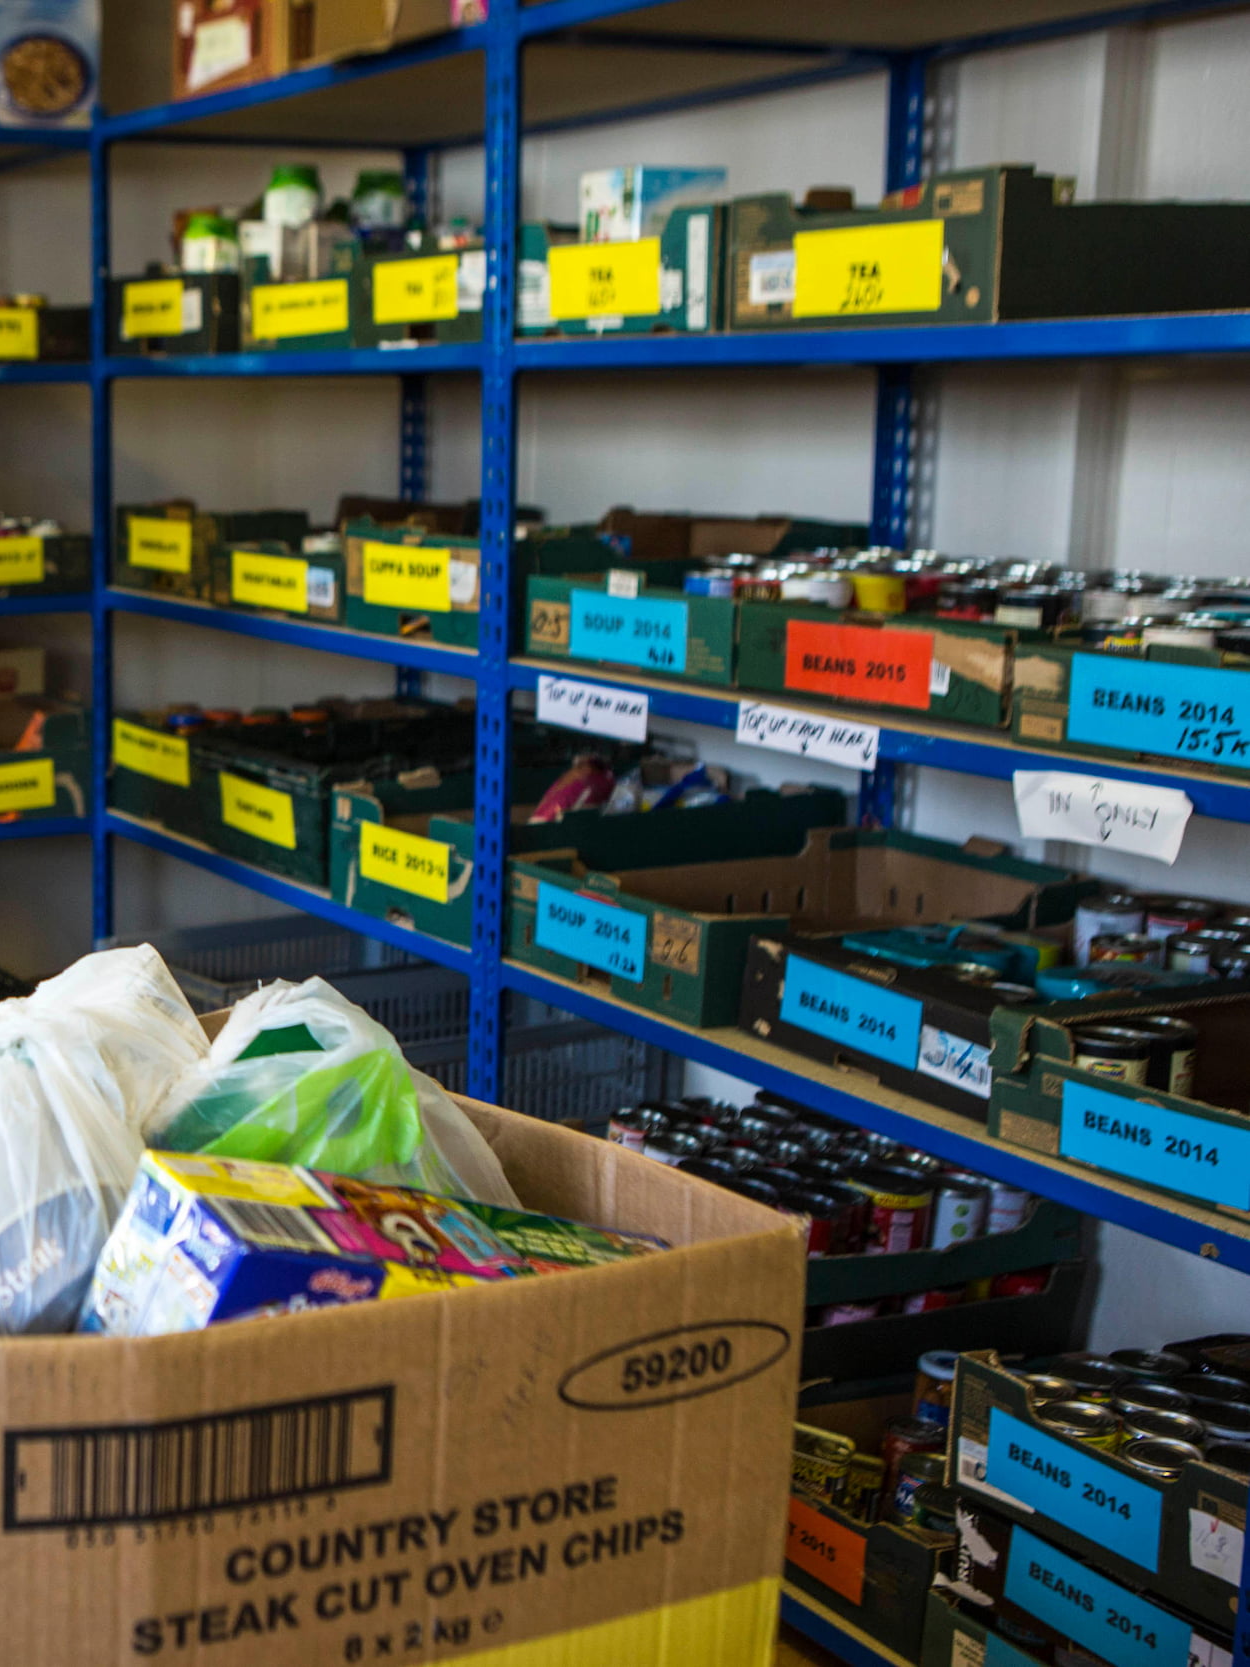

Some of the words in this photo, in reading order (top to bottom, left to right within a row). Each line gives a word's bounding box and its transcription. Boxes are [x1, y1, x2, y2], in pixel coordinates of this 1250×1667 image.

[849, 261, 879, 279] TEA
[369, 559, 404, 577] CUPPA
[408, 561, 442, 579] SOUP
[583, 613, 625, 632] SOUP
[634, 619, 671, 640] 2014
[803, 654, 855, 676] BEANS
[866, 661, 907, 682] 2015
[570, 689, 585, 706] UP
[1092, 688, 1165, 716] BEANS
[1179, 700, 1234, 726] 2014
[742, 703, 768, 731] TOP
[769, 716, 788, 732] UP
[789, 719, 826, 741] FROM
[828, 727, 865, 747] HERE
[1049, 791, 1073, 815] IN
[372, 843, 399, 865] RICE
[548, 903, 587, 928] SOUP
[595, 916, 631, 945] 2014
[799, 990, 850, 1023] BEANS
[858, 1013, 897, 1042] 2014
[1083, 1110, 1152, 1147] BEANS
[1164, 1135, 1219, 1167] 2014
[622, 1336, 732, 1393] 59200
[1008, 1442, 1071, 1488] BEANS
[1082, 1482, 1132, 1521] 2014
[226, 1510, 460, 1585] COUNTRY
[473, 1476, 618, 1538] STORE
[800, 1529, 836, 1563] 2015
[132, 1593, 300, 1657] STEAK
[316, 1574, 412, 1620] CUT
[424, 1543, 549, 1599] OVEN
[562, 1510, 685, 1569] CHIPS
[1029, 1560, 1094, 1613] BEANS
[1106, 1607, 1157, 1650] 2014
[373, 1632, 393, 1656] x
[403, 1621, 423, 1652] 2
[432, 1612, 471, 1645] kg
